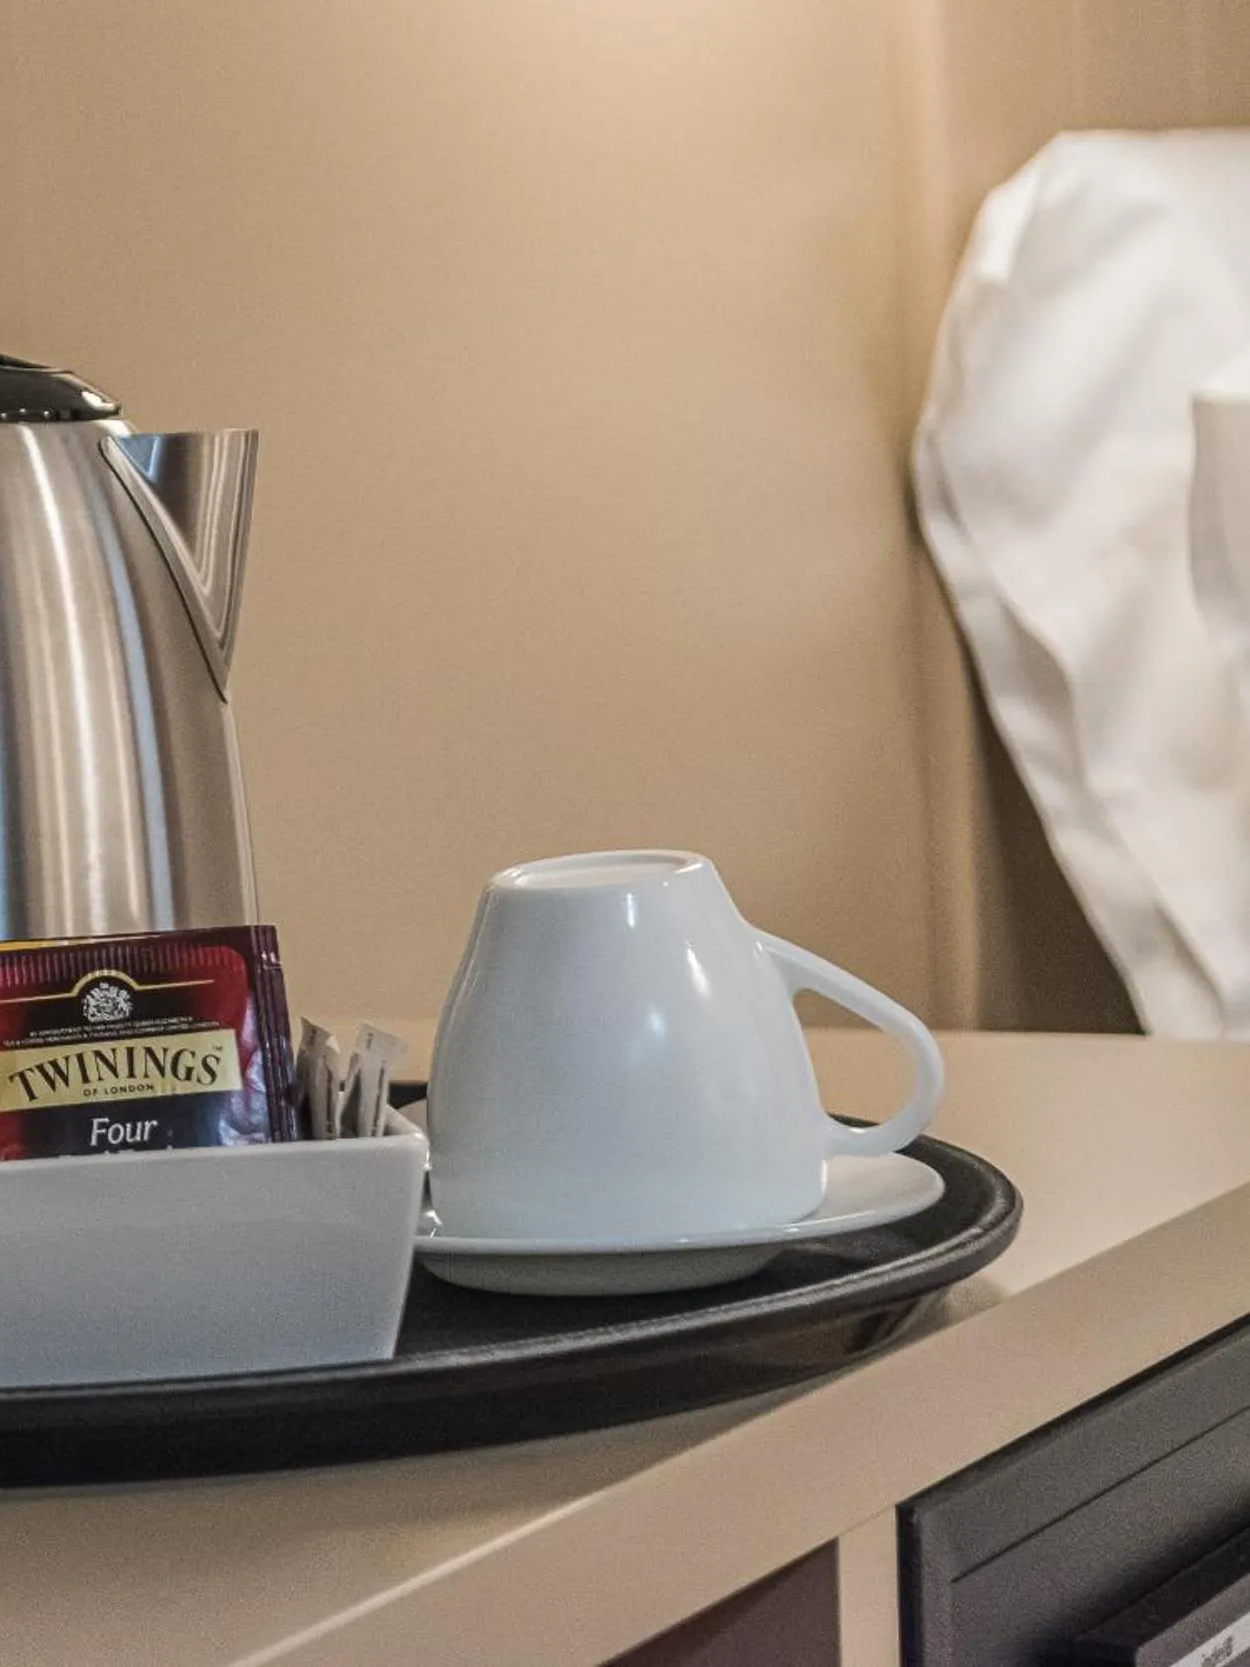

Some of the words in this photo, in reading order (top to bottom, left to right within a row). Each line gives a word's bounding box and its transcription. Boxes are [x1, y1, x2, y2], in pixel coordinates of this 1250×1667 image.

[8, 1045, 221, 1102] TWININGS
[83, 1088, 98, 1097] OF
[104, 1083, 155, 1096] LONDON
[90, 1117, 159, 1147] Four
